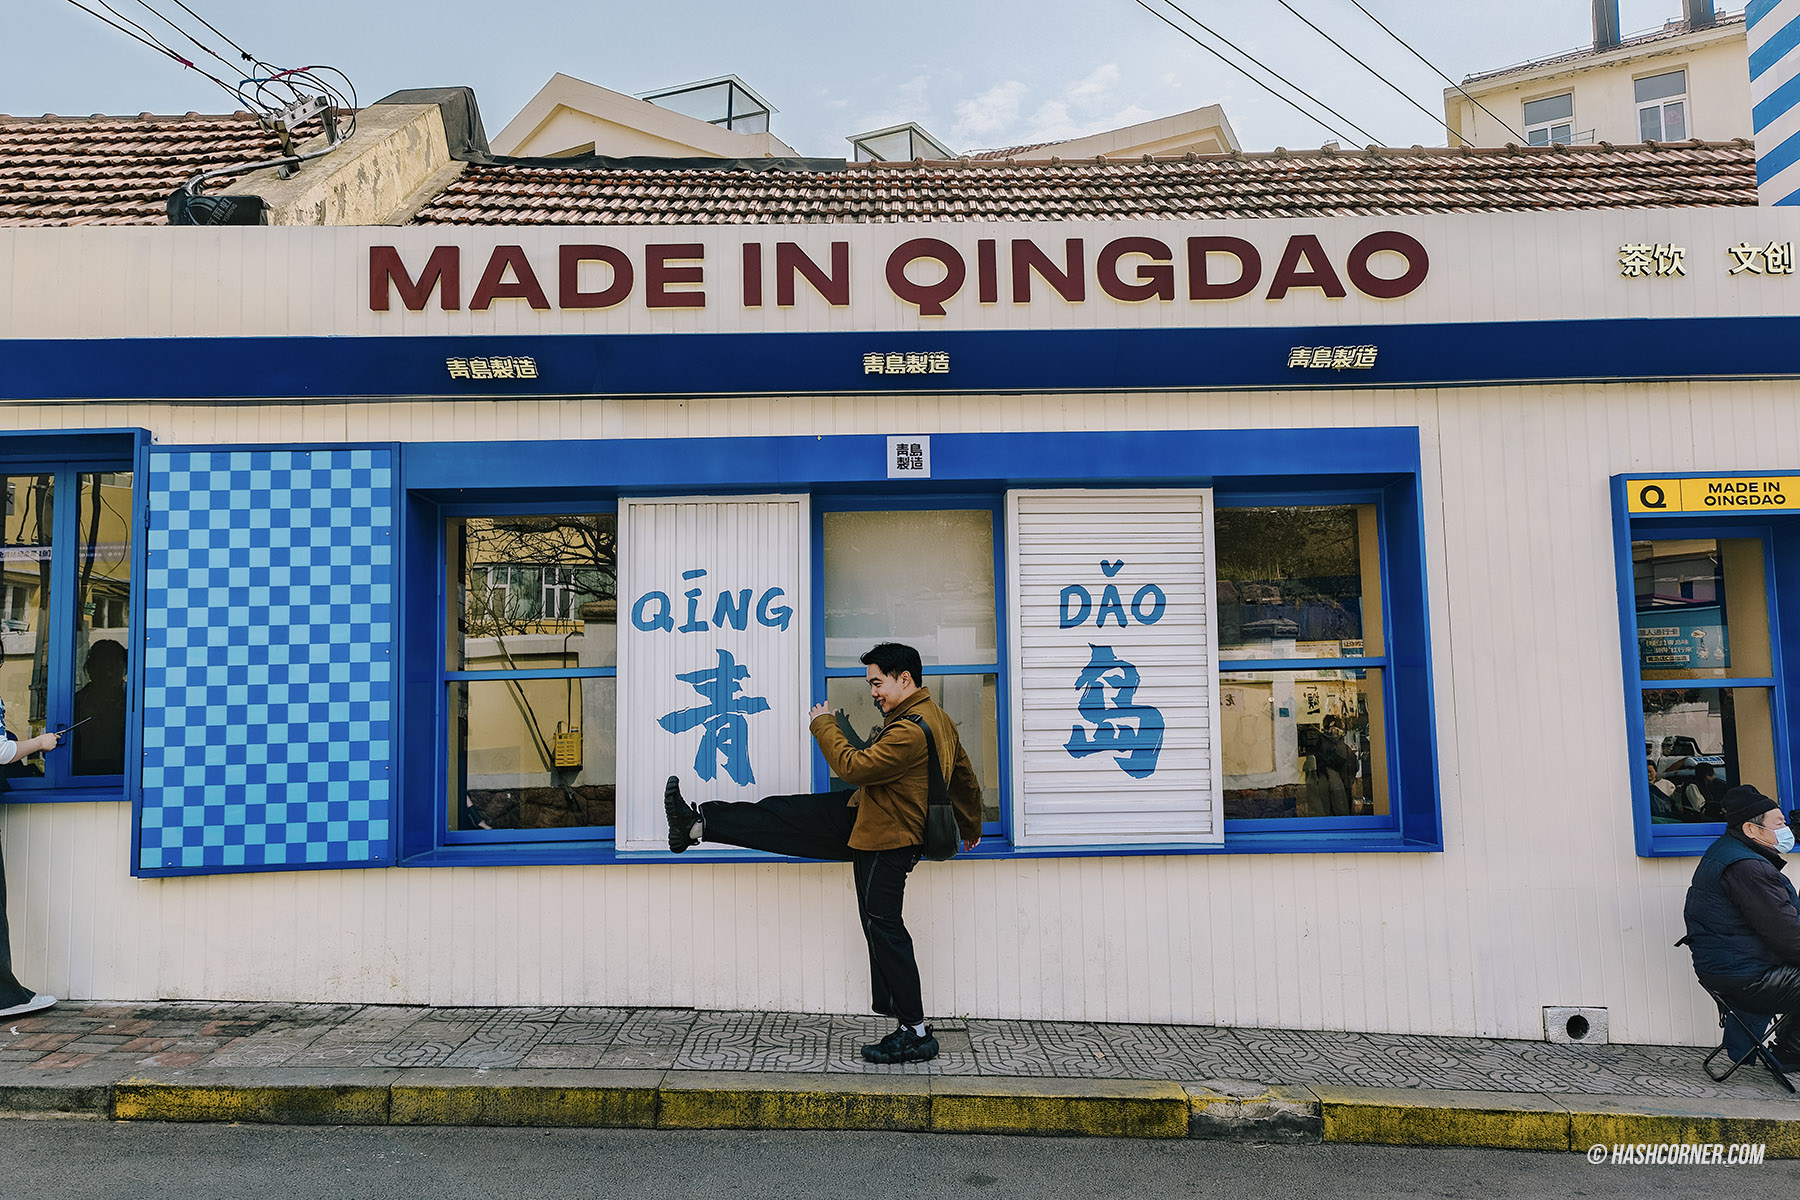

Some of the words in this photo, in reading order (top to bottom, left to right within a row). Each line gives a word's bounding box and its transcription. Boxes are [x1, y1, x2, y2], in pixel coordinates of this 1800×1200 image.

[369, 243, 706, 312] MADE
[742, 241, 851, 308] IN
[885, 230, 1430, 317] QINGDAO
[1619, 243, 1687, 277] 茶饮
[1727, 241, 1796, 276] 文创
[1640, 485, 1667, 509] Q
[1708, 482, 1758, 493] MADE
[1763, 481, 1781, 492] IN
[1059, 559, 1167, 629] DǍO
[657, 648, 771, 786] 青
[1062, 642, 1165, 779] 岛
